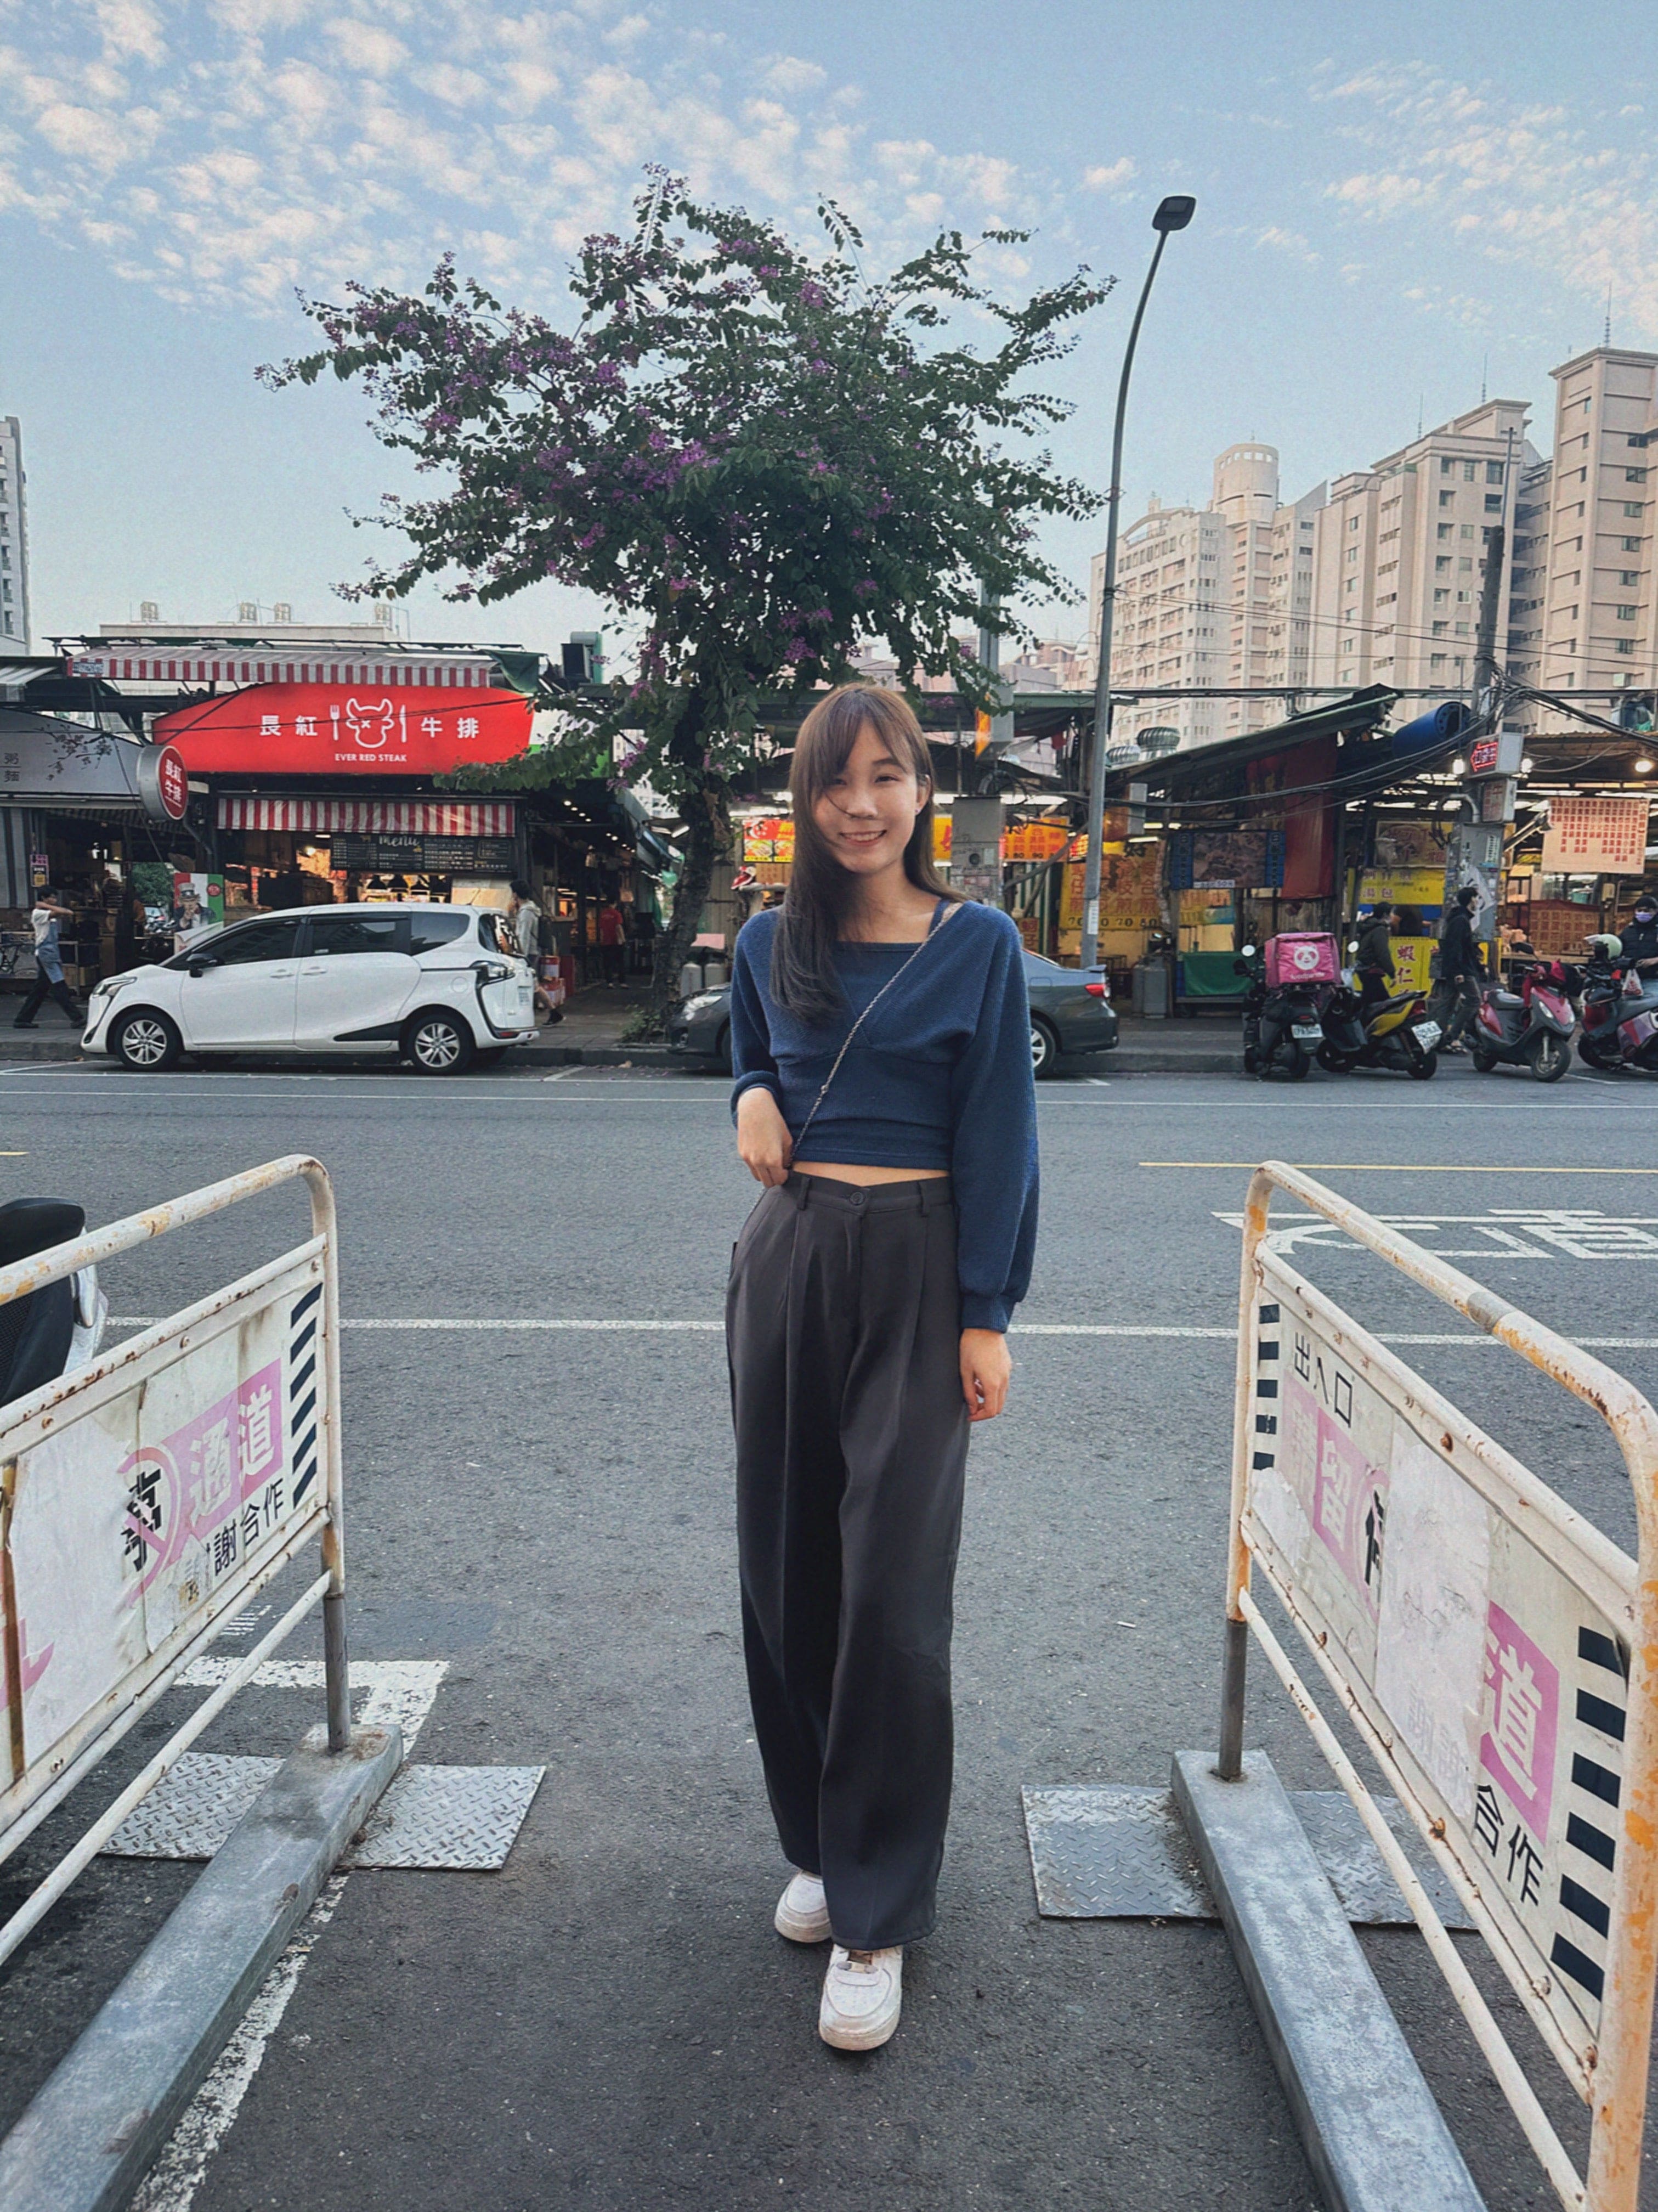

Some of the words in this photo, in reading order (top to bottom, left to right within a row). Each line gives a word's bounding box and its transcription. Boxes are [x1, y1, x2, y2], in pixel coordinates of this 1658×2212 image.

[260, 715, 318, 736] 長紅
[421, 718, 479, 739] 牛排
[335, 753, 357, 761] EVER
[359, 754, 376, 762] RED
[378, 754, 407, 763] STEAK
[1397, 946, 1416, 994] 蝦仁
[1294, 1332, 1353, 1428] 出入口
[206, 1478, 284, 1577] 謝合作
